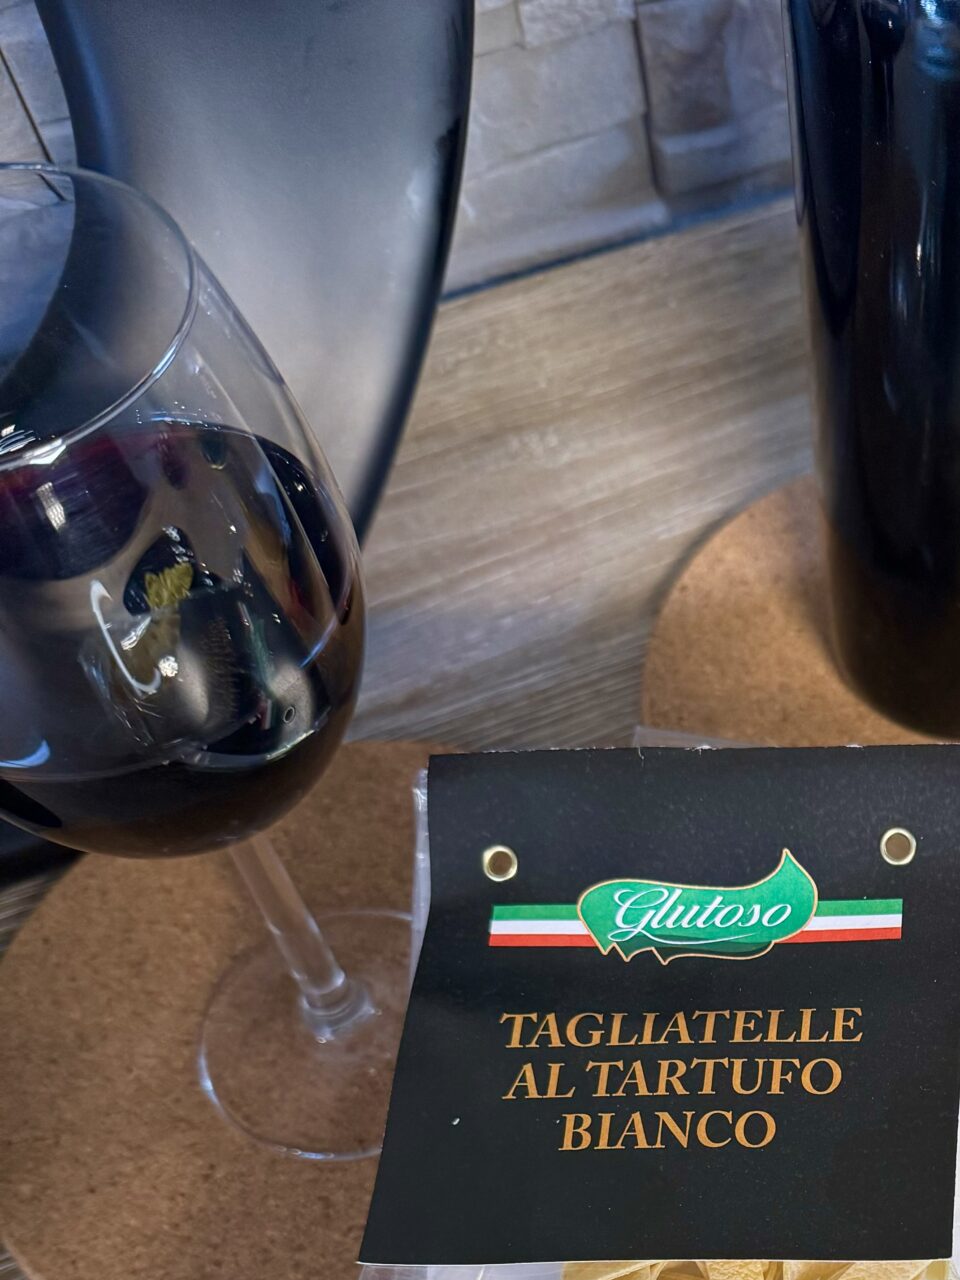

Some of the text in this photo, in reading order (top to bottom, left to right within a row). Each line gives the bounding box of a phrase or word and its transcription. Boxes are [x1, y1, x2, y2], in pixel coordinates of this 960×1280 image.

[607, 886, 793, 944] Glutoso
[499, 1006, 864, 1049] TAGLIATELLE
[501, 1057, 843, 1100] AL TARTUFO
[557, 1109, 778, 1151] BIANCO
